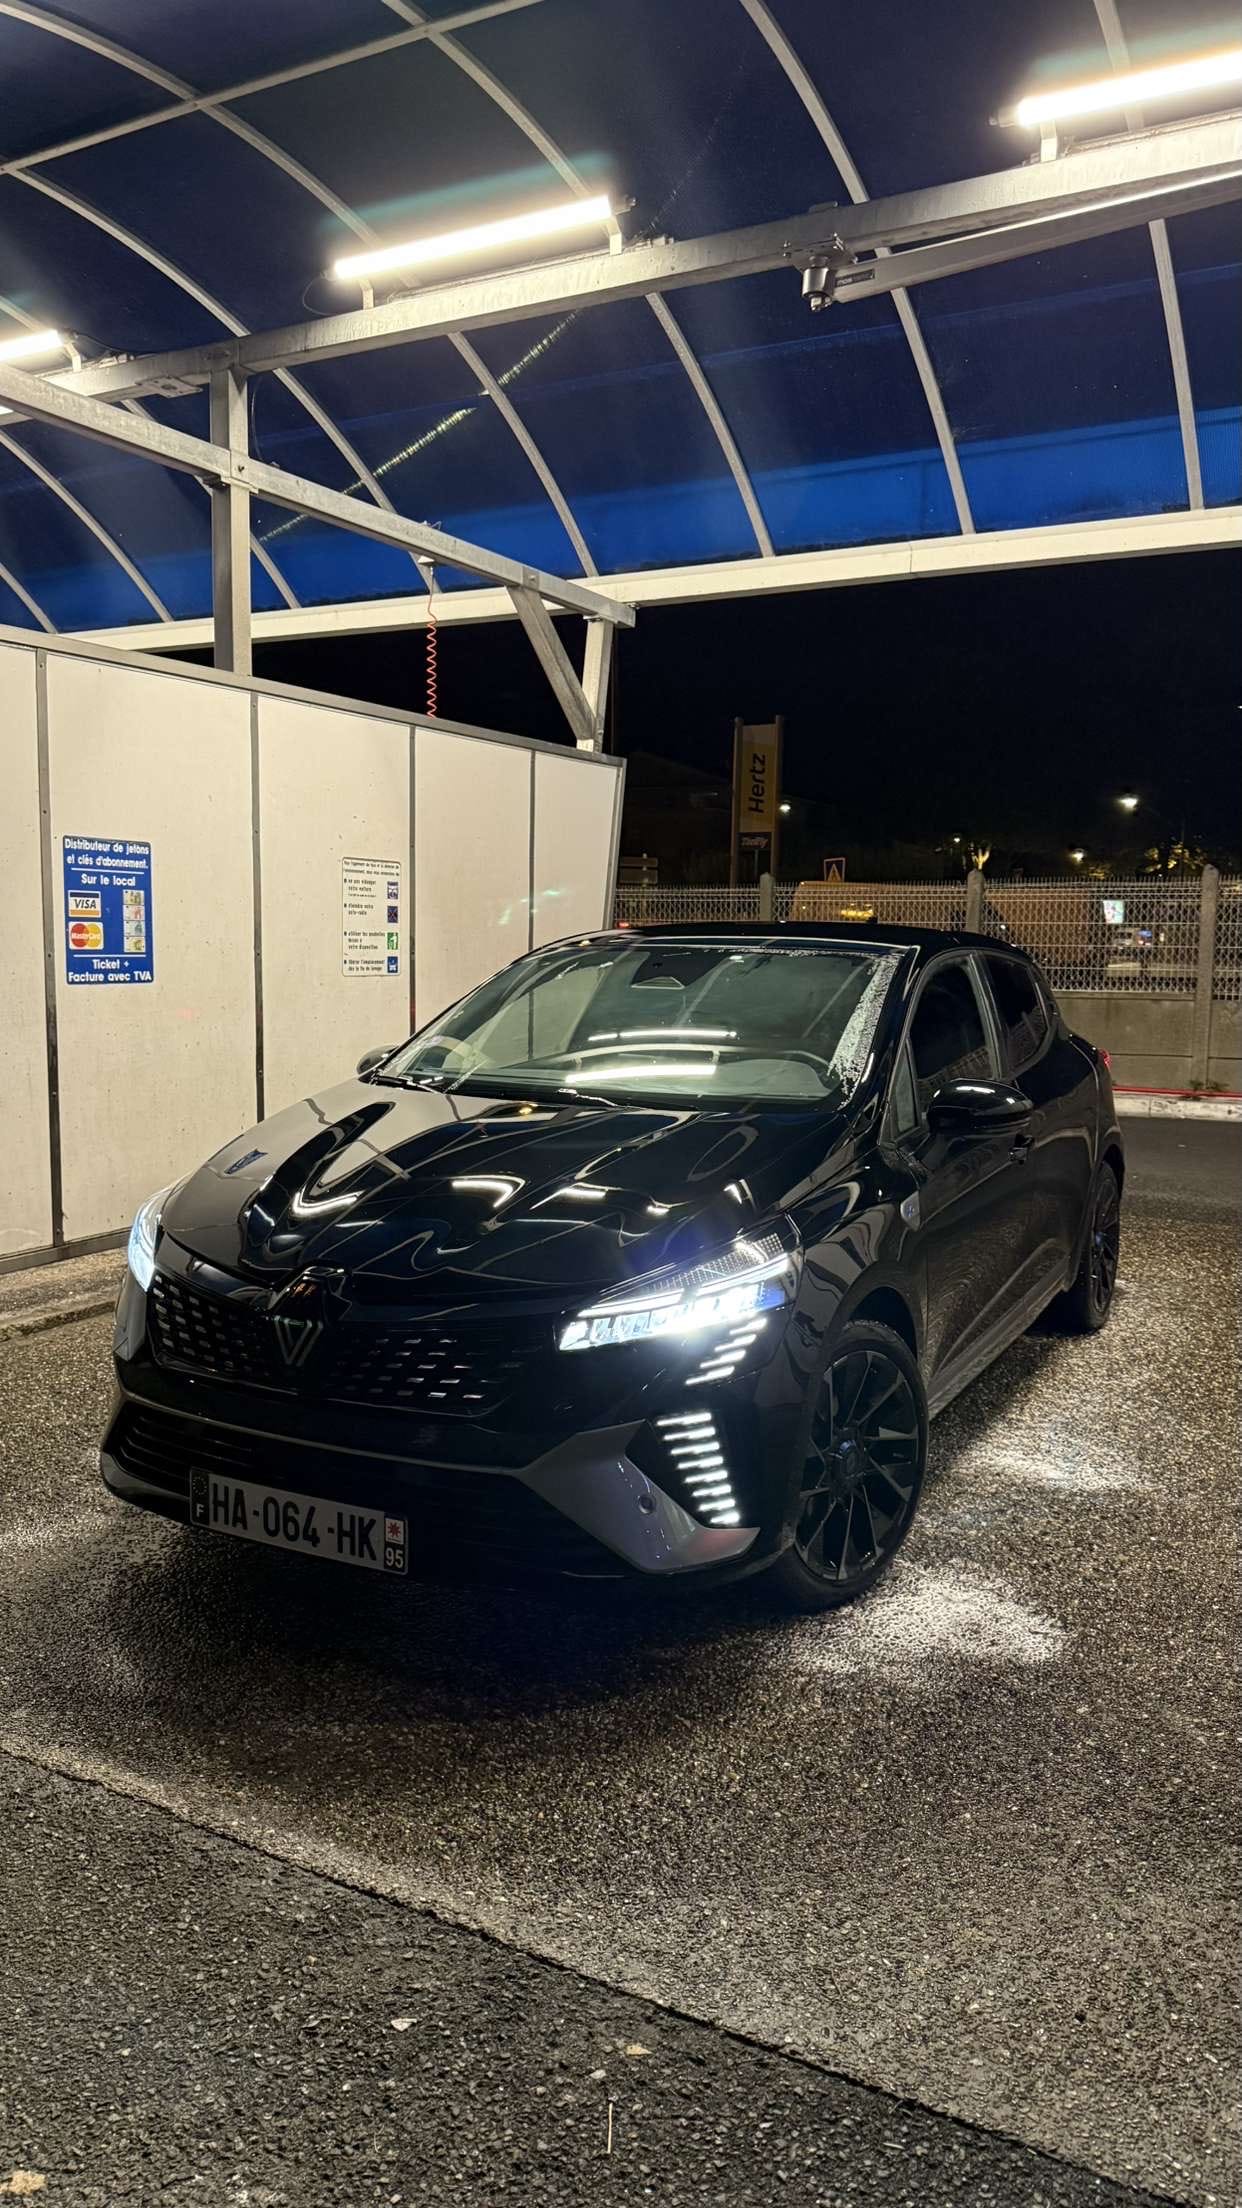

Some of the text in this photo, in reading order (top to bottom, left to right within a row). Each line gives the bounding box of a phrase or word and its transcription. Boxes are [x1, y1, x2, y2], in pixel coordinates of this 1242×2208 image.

[748, 753, 766, 814] Hertz
[64, 838, 149, 855] Distributeur de jetons
[66, 854, 75, 864] et
[78, 854, 93, 865] clés
[81, 873, 136, 886] Sur le local
[74, 899, 97, 909] VISA
[92, 959, 120, 970] Ticket
[68, 971, 152, 982] Facture avec TVA
[196, 1503, 205, 1517] F
[385, 1547, 404, 1569] 95
